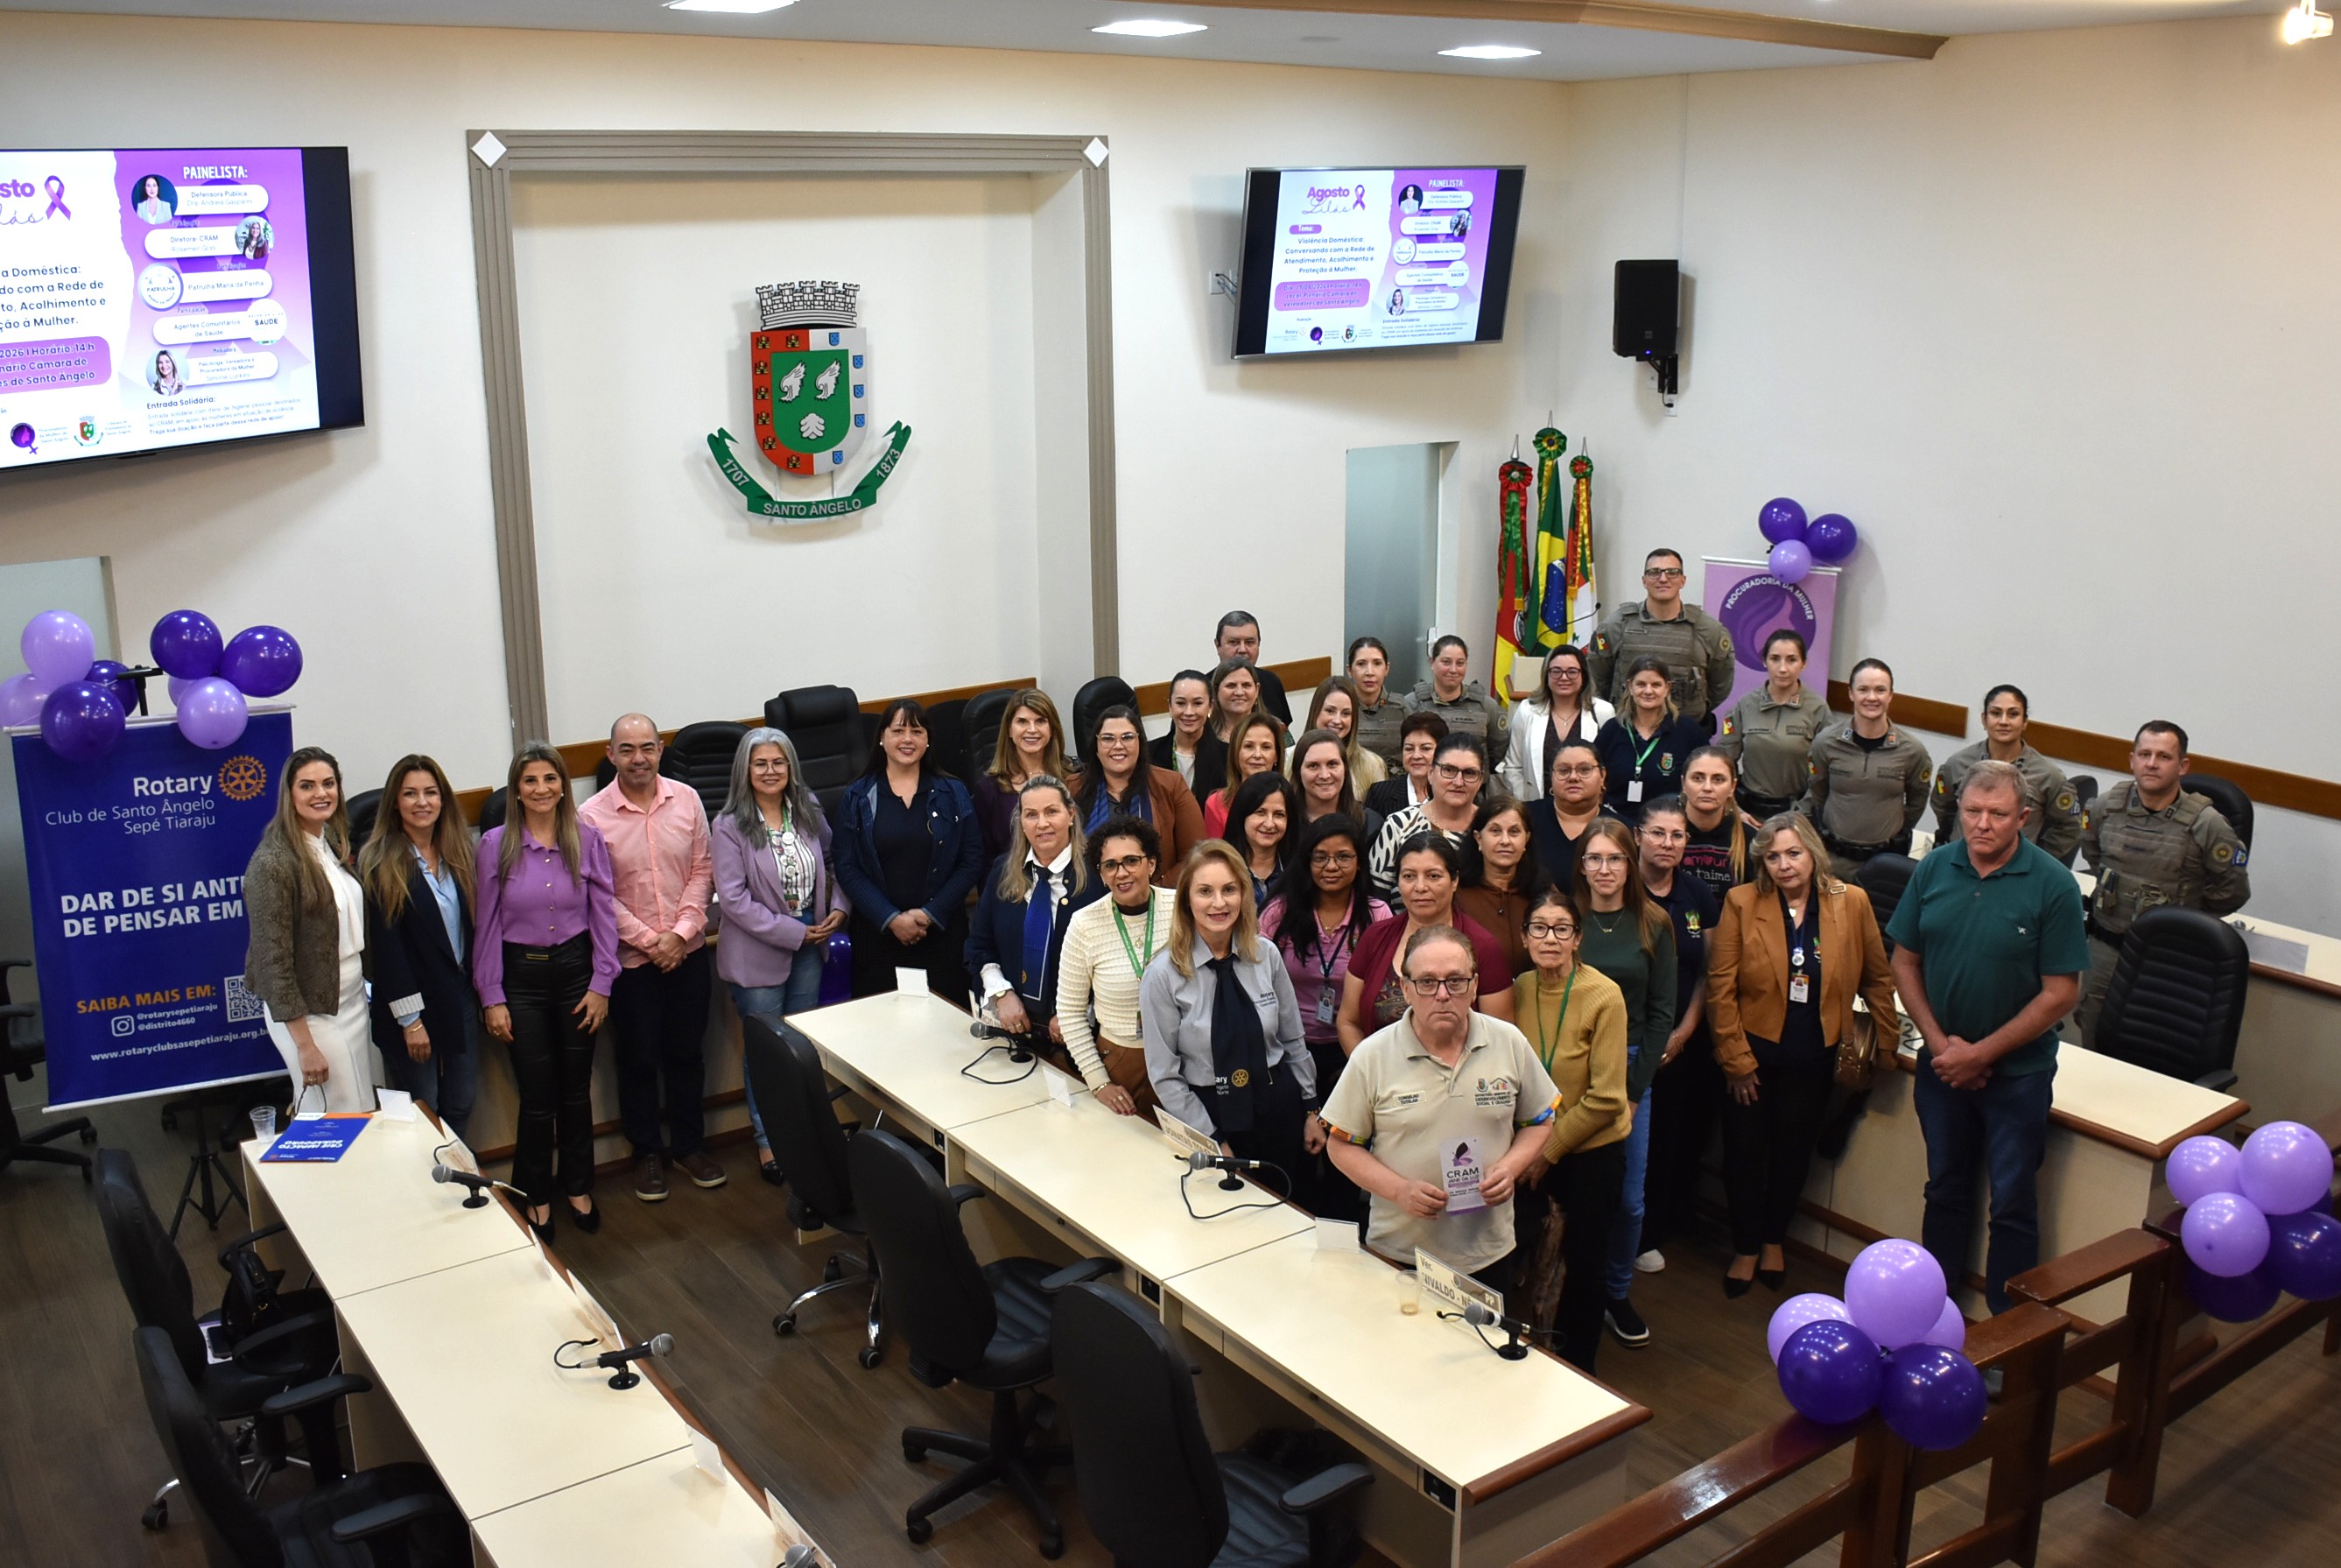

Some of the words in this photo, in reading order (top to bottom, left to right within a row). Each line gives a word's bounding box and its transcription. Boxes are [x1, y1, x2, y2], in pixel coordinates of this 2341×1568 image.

[183, 165, 248, 179] PAINELISTA:
[1307, 186, 1350, 201] Agosto
[12, 264, 81, 278] Doméstica:
[18, 285, 44, 293] com
[58, 281, 87, 292] Rede
[89, 280, 104, 289] de
[20, 298, 96, 311] Acolhimento
[33, 316, 79, 327] Mulher.
[32, 344, 74, 356] Horário:
[75, 343, 86, 352] 14
[88, 342, 95, 351] h
[29, 358, 72, 370] Câmara
[74, 357, 88, 366] de
[11, 376, 25, 385] de
[26, 374, 57, 384] Santo
[60, 370, 95, 383] Ângelo
[146, 400, 179, 410] Entrada
[179, 396, 216, 407] Solidária:
[876, 448, 901, 480] 1873
[721, 459, 749, 486] 1707
[763, 503, 806, 516] SANTO
[810, 498, 861, 517] ÂNGELO
[1726, 577, 1781, 609] PROCURADORIA
[1794, 589, 1814, 620] MULHER
[133, 775, 213, 797] Rotary
[46, 810, 82, 826] Club
[88, 807, 107, 822] de
[112, 805, 156, 820] Santo
[161, 797, 214, 816] Ângelo
[124, 819, 161, 835] Sepé
[165, 813, 215, 829] Tiaraju
[60, 891, 115, 914] DAR
[122, 887, 155, 908] DE
[161, 882, 184, 904] SI
[63, 917, 97, 938] DE
[104, 905, 200, 934] PENSAR
[207, 899, 243, 921] EM
[76, 995, 130, 1014] SAIBA
[136, 988, 180, 1006] MAIS
[186, 984, 216, 1000] EM:
[137, 1003, 218, 1021] @rotarysepetiaraju
[137, 1016, 196, 1031] @distrito4660
[1446, 1167, 1479, 1178] CRAM
[1420, 1255, 1433, 1271] Ver.
[1485, 1292, 1494, 1305] PP
